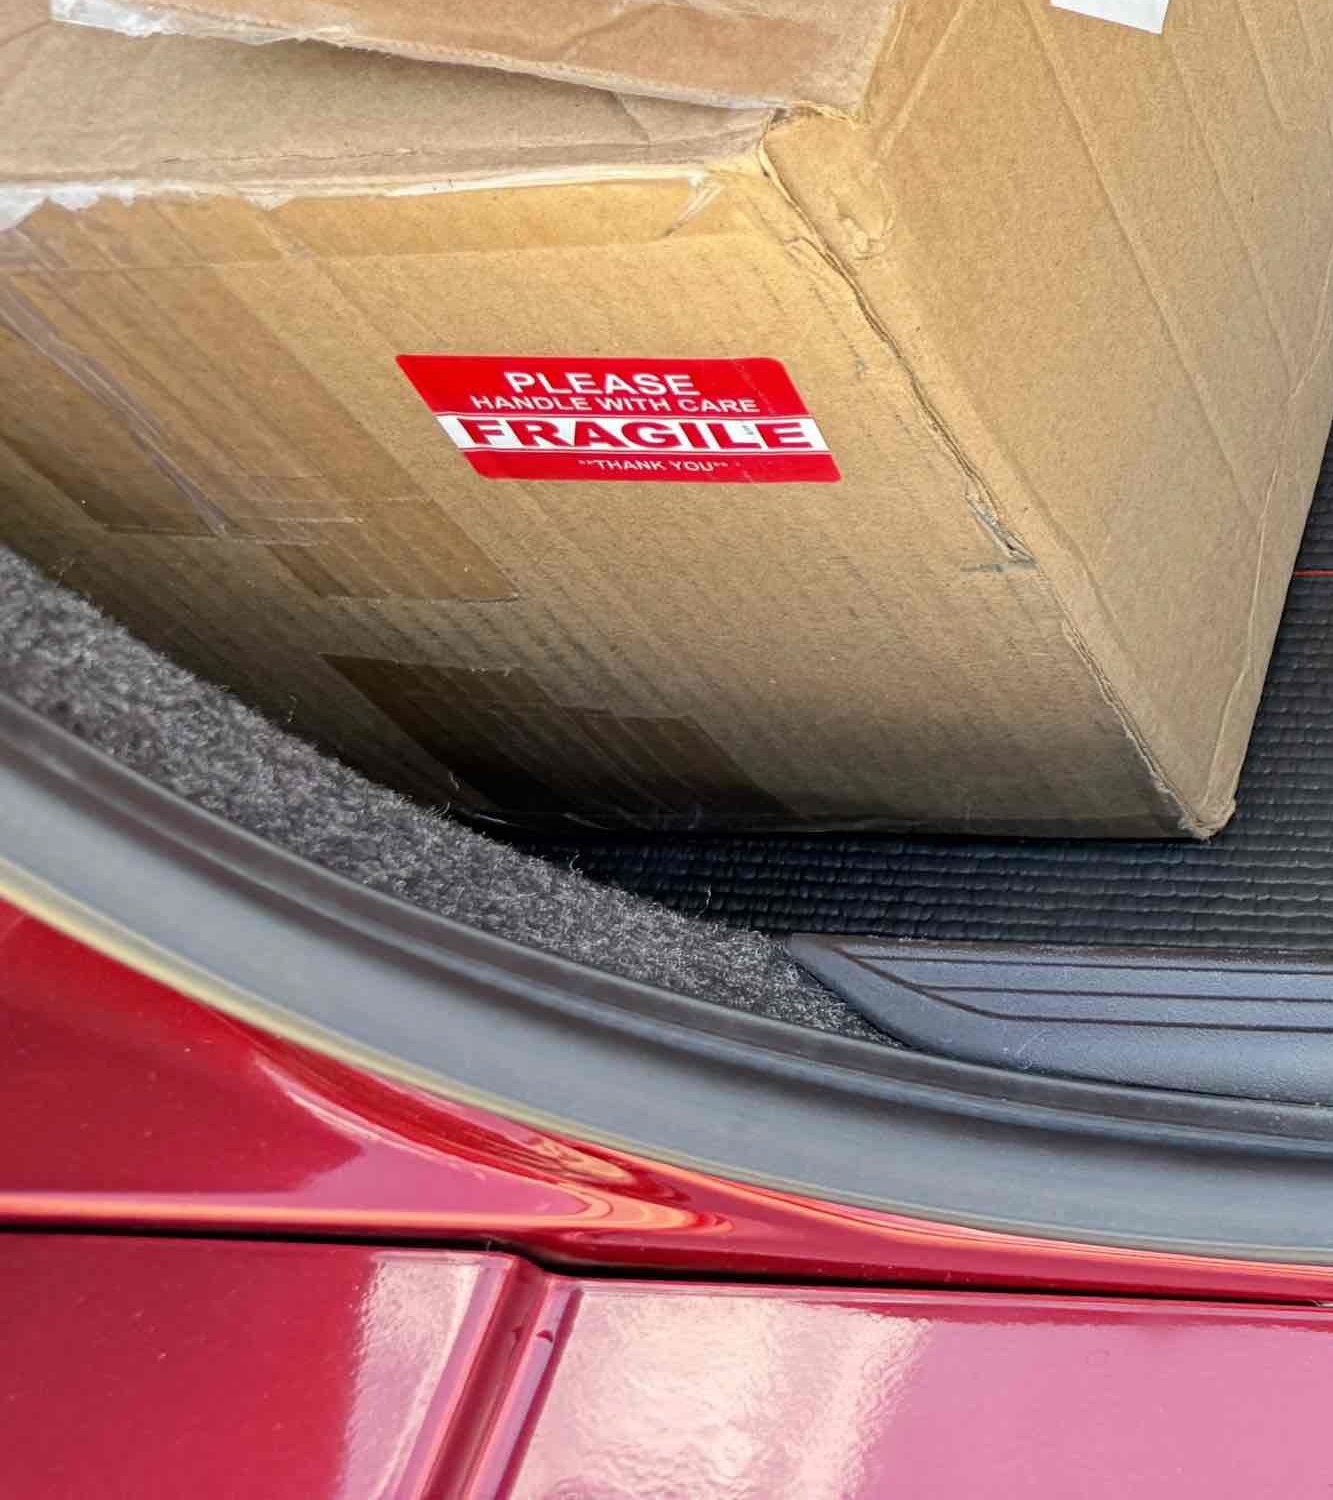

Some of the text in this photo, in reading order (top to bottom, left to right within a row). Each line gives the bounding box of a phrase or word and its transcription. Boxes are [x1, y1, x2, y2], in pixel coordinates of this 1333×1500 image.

[504, 371, 701, 397] PLEASE
[471, 394, 761, 414] HANDLE WITH CARE
[457, 418, 813, 450] FRAGILE
